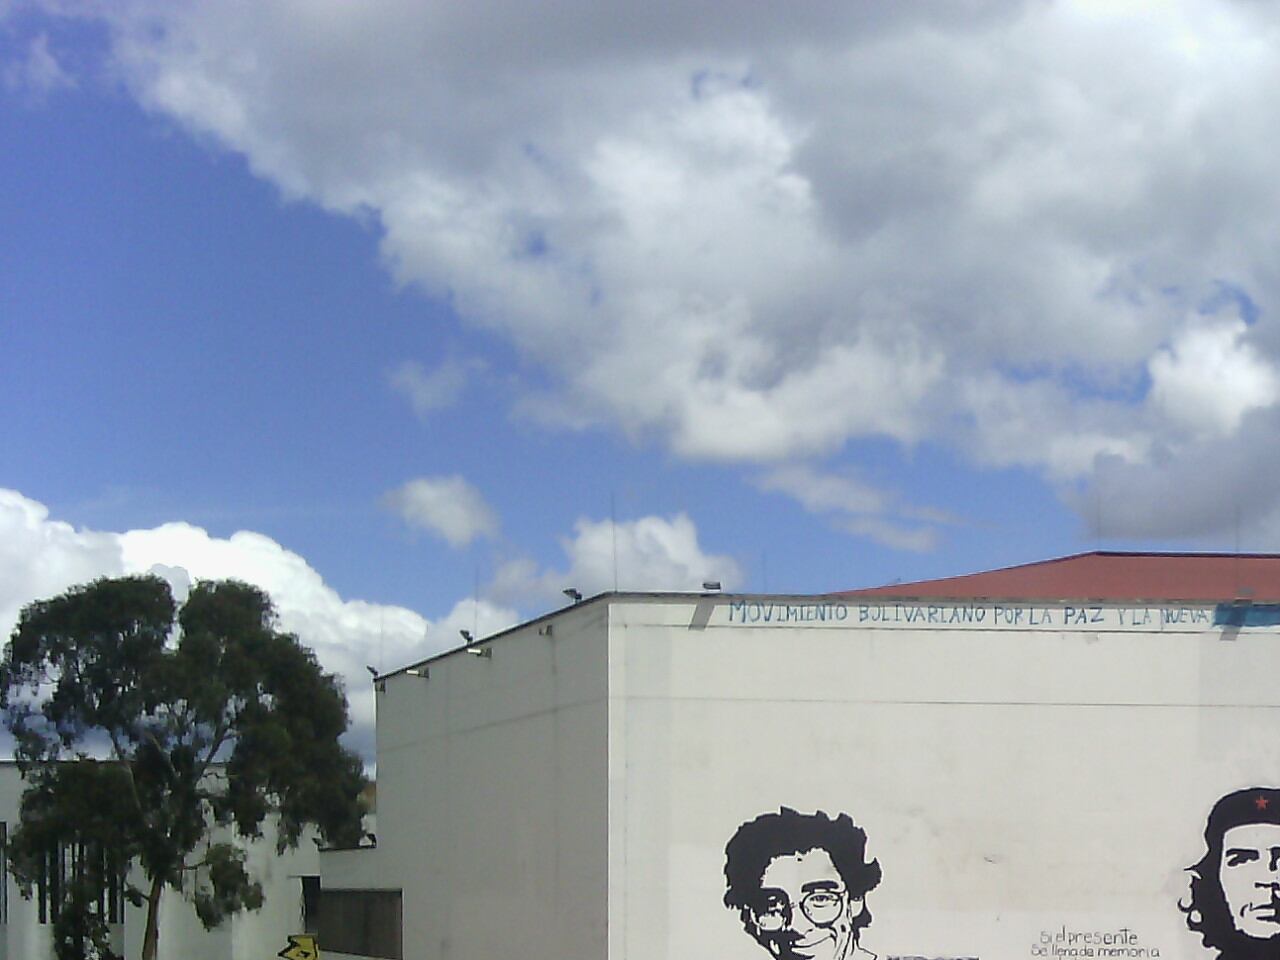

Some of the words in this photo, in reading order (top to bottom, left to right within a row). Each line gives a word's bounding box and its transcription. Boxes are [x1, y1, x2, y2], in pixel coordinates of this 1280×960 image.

[729, 601, 848, 624] MOVIMIENTO
[859, 604, 986, 624] BOLIVARIANO
[994, 606, 1023, 625] POR
[1029, 607, 1053, 626] LA
[1064, 606, 1105, 625] PAZ
[1132, 608, 1151, 626] LA
[1068, 928, 1138, 946] presente
[1097, 947, 1160, 959] memoria
